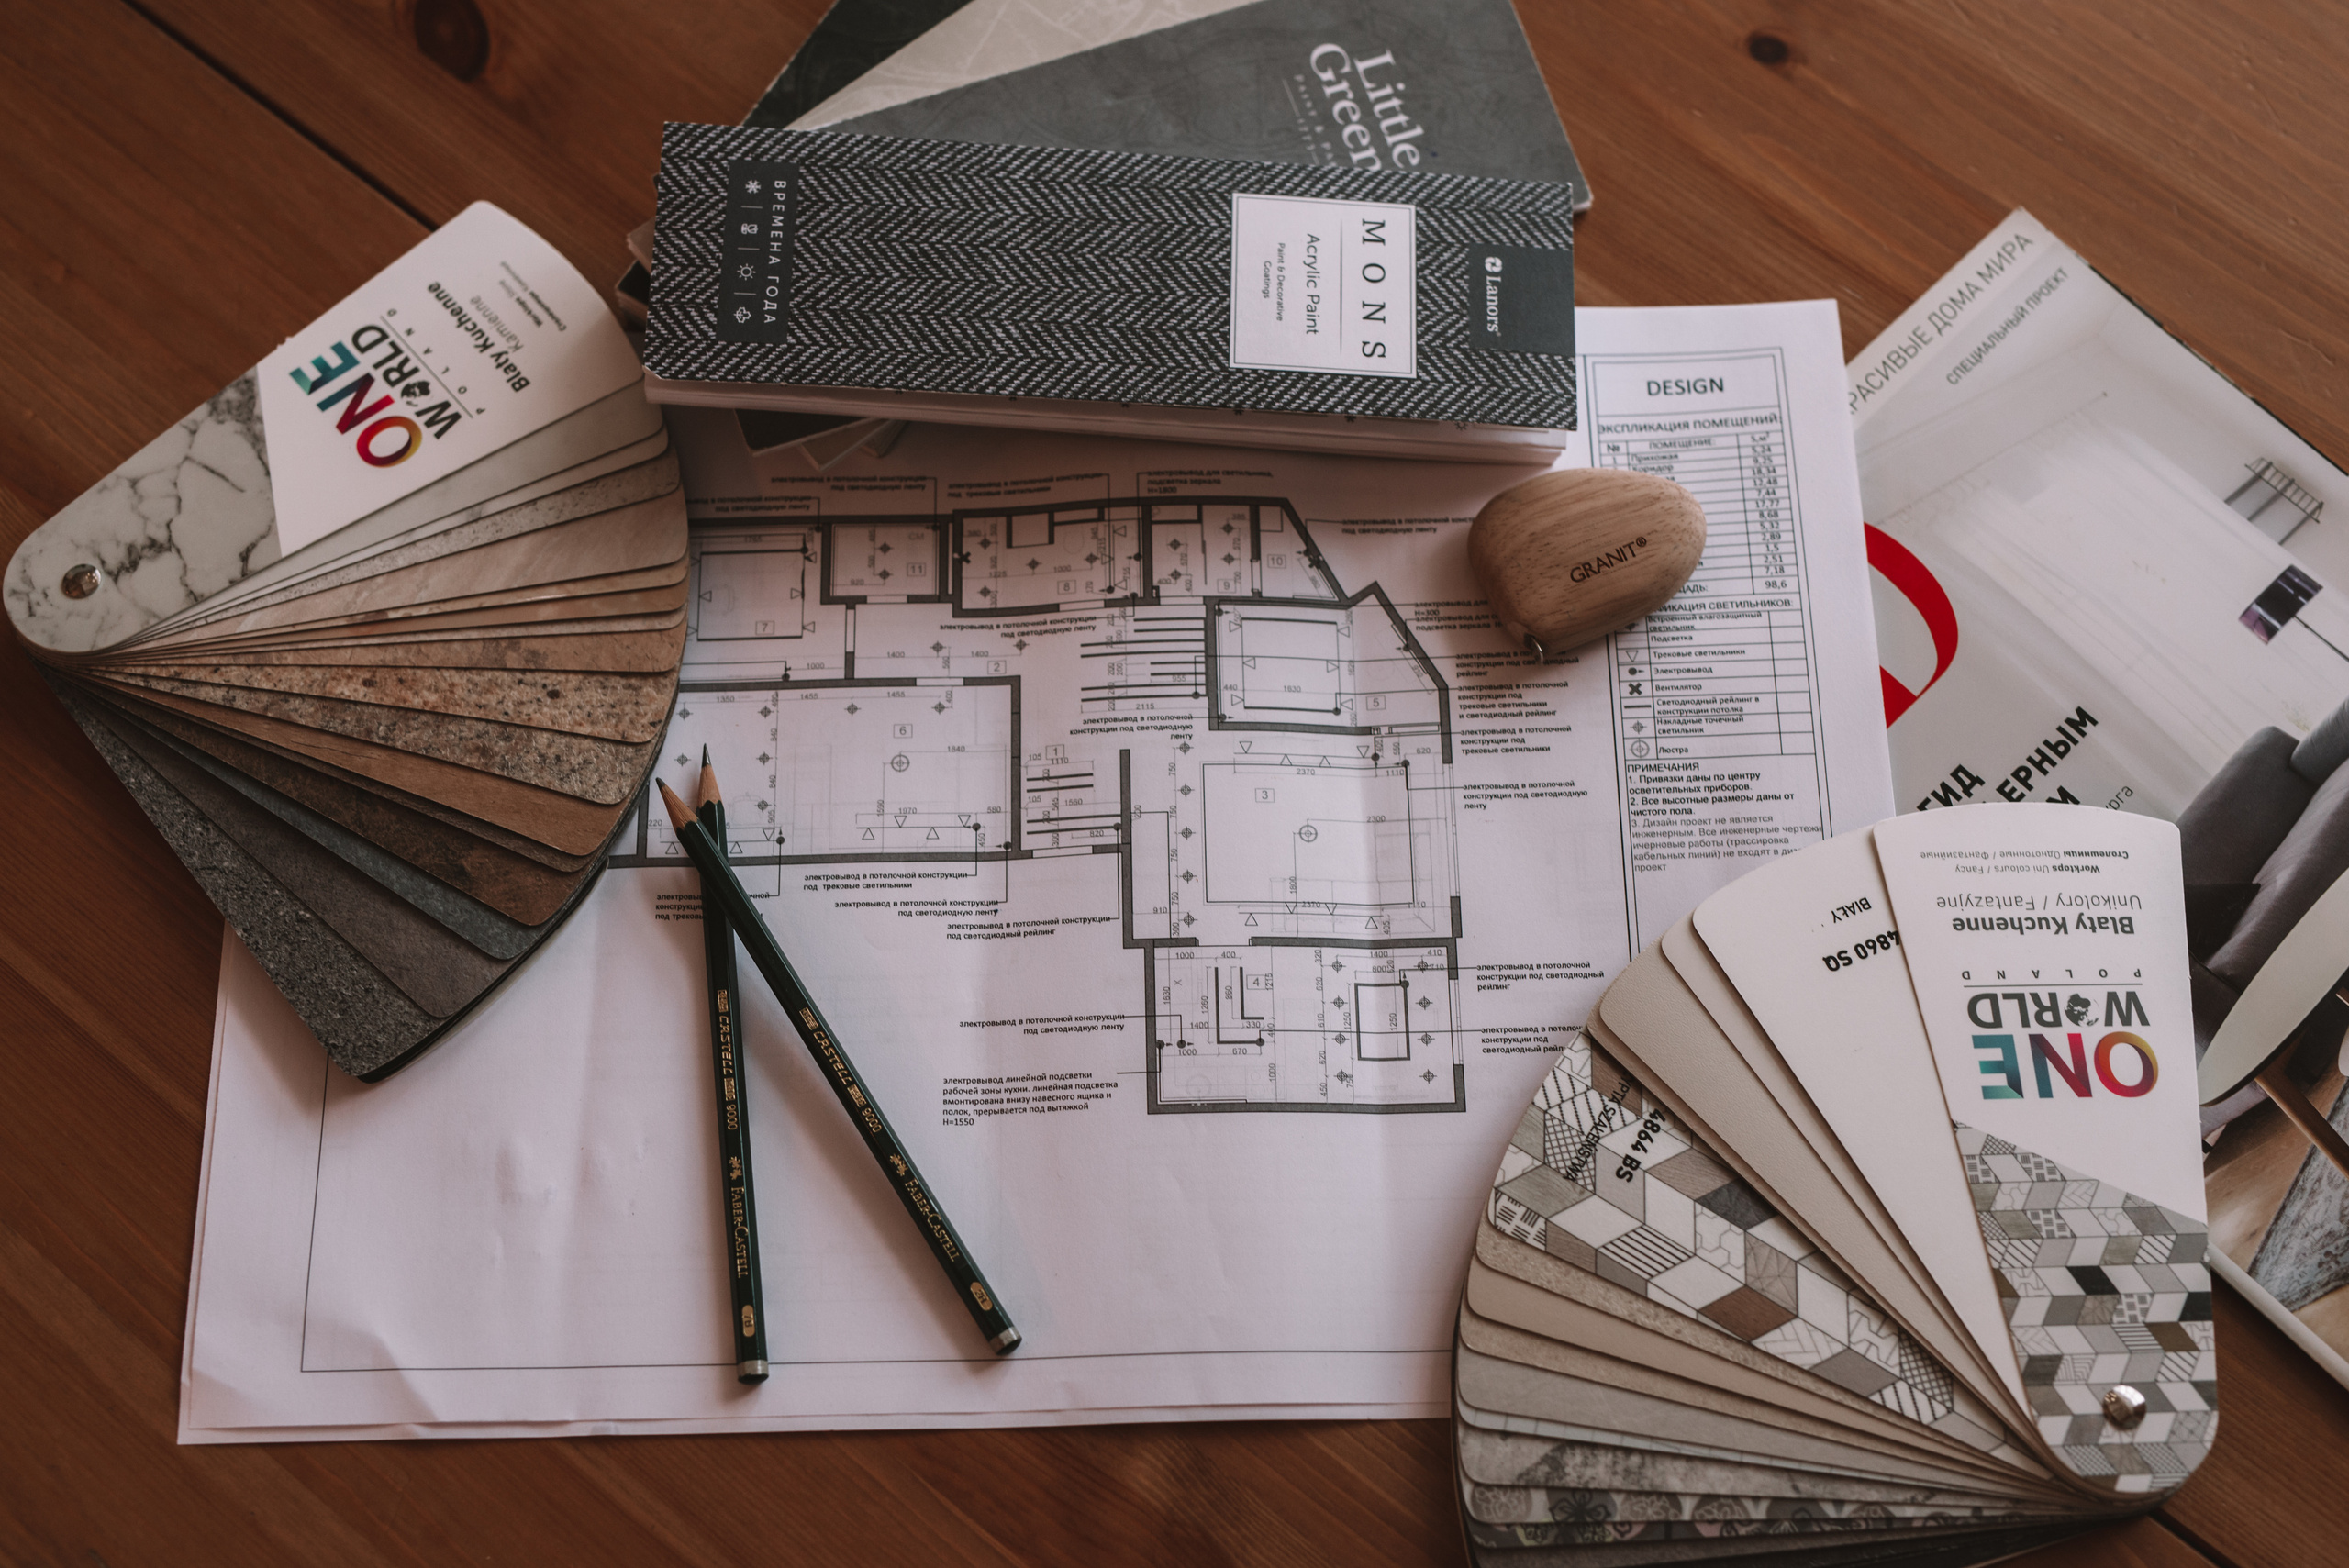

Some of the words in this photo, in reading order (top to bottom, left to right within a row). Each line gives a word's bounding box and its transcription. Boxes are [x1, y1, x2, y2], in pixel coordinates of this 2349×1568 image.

[1309, 42, 1384, 171] Green
[1353, 49, 1425, 169] Little
[769, 180, 786, 264] ВРЕМЕНА
[1277, 242, 1286, 263] Paint
[1302, 233, 1320, 289] Acrylic
[1263, 261, 1272, 300] Coatings
[1362, 217, 1386, 359] MONS
[763, 276, 779, 323] ГОДА
[1275, 275, 1285, 322] Decorative
[428, 281, 495, 353] Kuchenne
[1306, 295, 1320, 335] Paint
[470, 295, 525, 353] Kamienne
[1847, 325, 1933, 416] РАСИВЫЕ
[1928, 279, 1984, 336] ДОМА
[1977, 232, 2033, 287] МИРА
[1946, 304, 2027, 386] СПЕЦИАЛЬНЫЙ
[2025, 267, 2070, 312] ПРОЕКТ
[490, 345, 531, 393] Blaty
[1646, 377, 1725, 396] DESIGN
[289, 340, 423, 468] ONE
[1598, 420, 1690, 434] ЭКСПЛИКАЦИЯ
[1765, 580, 1787, 589] 98,6
[1653, 650, 1692, 659] Трековые
[1653, 666, 1713, 675] Электровывод
[1655, 684, 1702, 693] Вентилятор
[1656, 696, 1718, 706] Светодиодный
[1719, 696, 1753, 706] рейлинг
[1657, 708, 1709, 717] конструкции
[1657, 727, 1704, 735] светильник
[1658, 746, 1688, 755] Люстра
[1996, 706, 2099, 804] ЕРНЫМ
[1627, 762, 1699, 773] ПРИМЕЧАНИЯ
[1639, 774, 1684, 784] Привязки
[1687, 773, 1711, 783] даны
[1727, 772, 1761, 782] центру
[1629, 785, 1701, 795] осветительных
[1704, 783, 1752, 793] приборов.
[1642, 796, 1660, 806] Все
[1662, 795, 1709, 804] высотные
[1711, 794, 1753, 805] размеры
[1756, 793, 1781, 802] даны
[1631, 808, 1667, 817] чистого
[1642, 817, 1676, 828] Дизайн
[1680, 817, 1711, 827] проект
[1729, 815, 1773, 823] является
[1698, 828, 1717, 836] Все
[1720, 825, 1779, 834] инженерные
[1687, 837, 1723, 848] работы
[1633, 851, 1686, 861] кабельных
[1737, 846, 1771, 856] входят
[1999, 850, 2061, 861] Однотонные
[2063, 850, 2130, 861] Столешницы
[1634, 864, 1667, 873] проект
[1955, 864, 1985, 874] Fancy
[1994, 865, 2031, 874] colours
[2032, 865, 2050, 873] Uni
[2053, 864, 2101, 875] Worktops
[1936, 894, 2036, 911] Fantazyjne
[2056, 892, 2143, 911] Unikolory
[1951, 916, 2069, 935] Kuchenne
[2075, 915, 2134, 935] Blaty
[1854, 929, 1901, 961] 4860
[1477, 963, 1533, 972] электровывод
[1542, 962, 1590, 970] потолочной
[1822, 949, 1853, 973] SQ
[1476, 973, 1527, 982] конструкции
[1545, 970, 1604, 980] светодиодный
[1961, 968, 2143, 980] POLAND
[1477, 984, 1510, 993] рейлинг
[959, 1018, 1017, 1029] электровывод
[1025, 1015, 1073, 1025] потолочной
[1074, 1013, 1125, 1023] конструкции
[1040, 1024, 1099, 1035] светодиодную
[1101, 1023, 1125, 1032] ленту
[718, 1016, 733, 1074] CASTELL
[1971, 1030, 2159, 1100] ONE
[813, 1030, 852, 1085] CASTELL
[862, 1106, 882, 1133] 9000
[943, 1075, 1004, 1085] электровывод
[1006, 1073, 1047, 1084] линейной
[1049, 1072, 1093, 1082] подсветки
[942, 1085, 979, 1096] рабочей
[1032, 1082, 1073, 1092] линейная
[1074, 1081, 1119, 1091] подсветка
[943, 1097, 1004, 1106] вмонтирована
[1006, 1095, 1030, 1106] внизу
[1032, 1094, 1074, 1103] навесного
[1076, 1093, 1104, 1102] ящика
[725, 1103, 738, 1130] 9000
[973, 1105, 1027, 1118] прерывается
[1029, 1105, 1045, 1114] под
[1047, 1102, 1089, 1112] вытяжкой
[1631, 1108, 1666, 1154] 4864
[1615, 1153, 1642, 1183] BS
